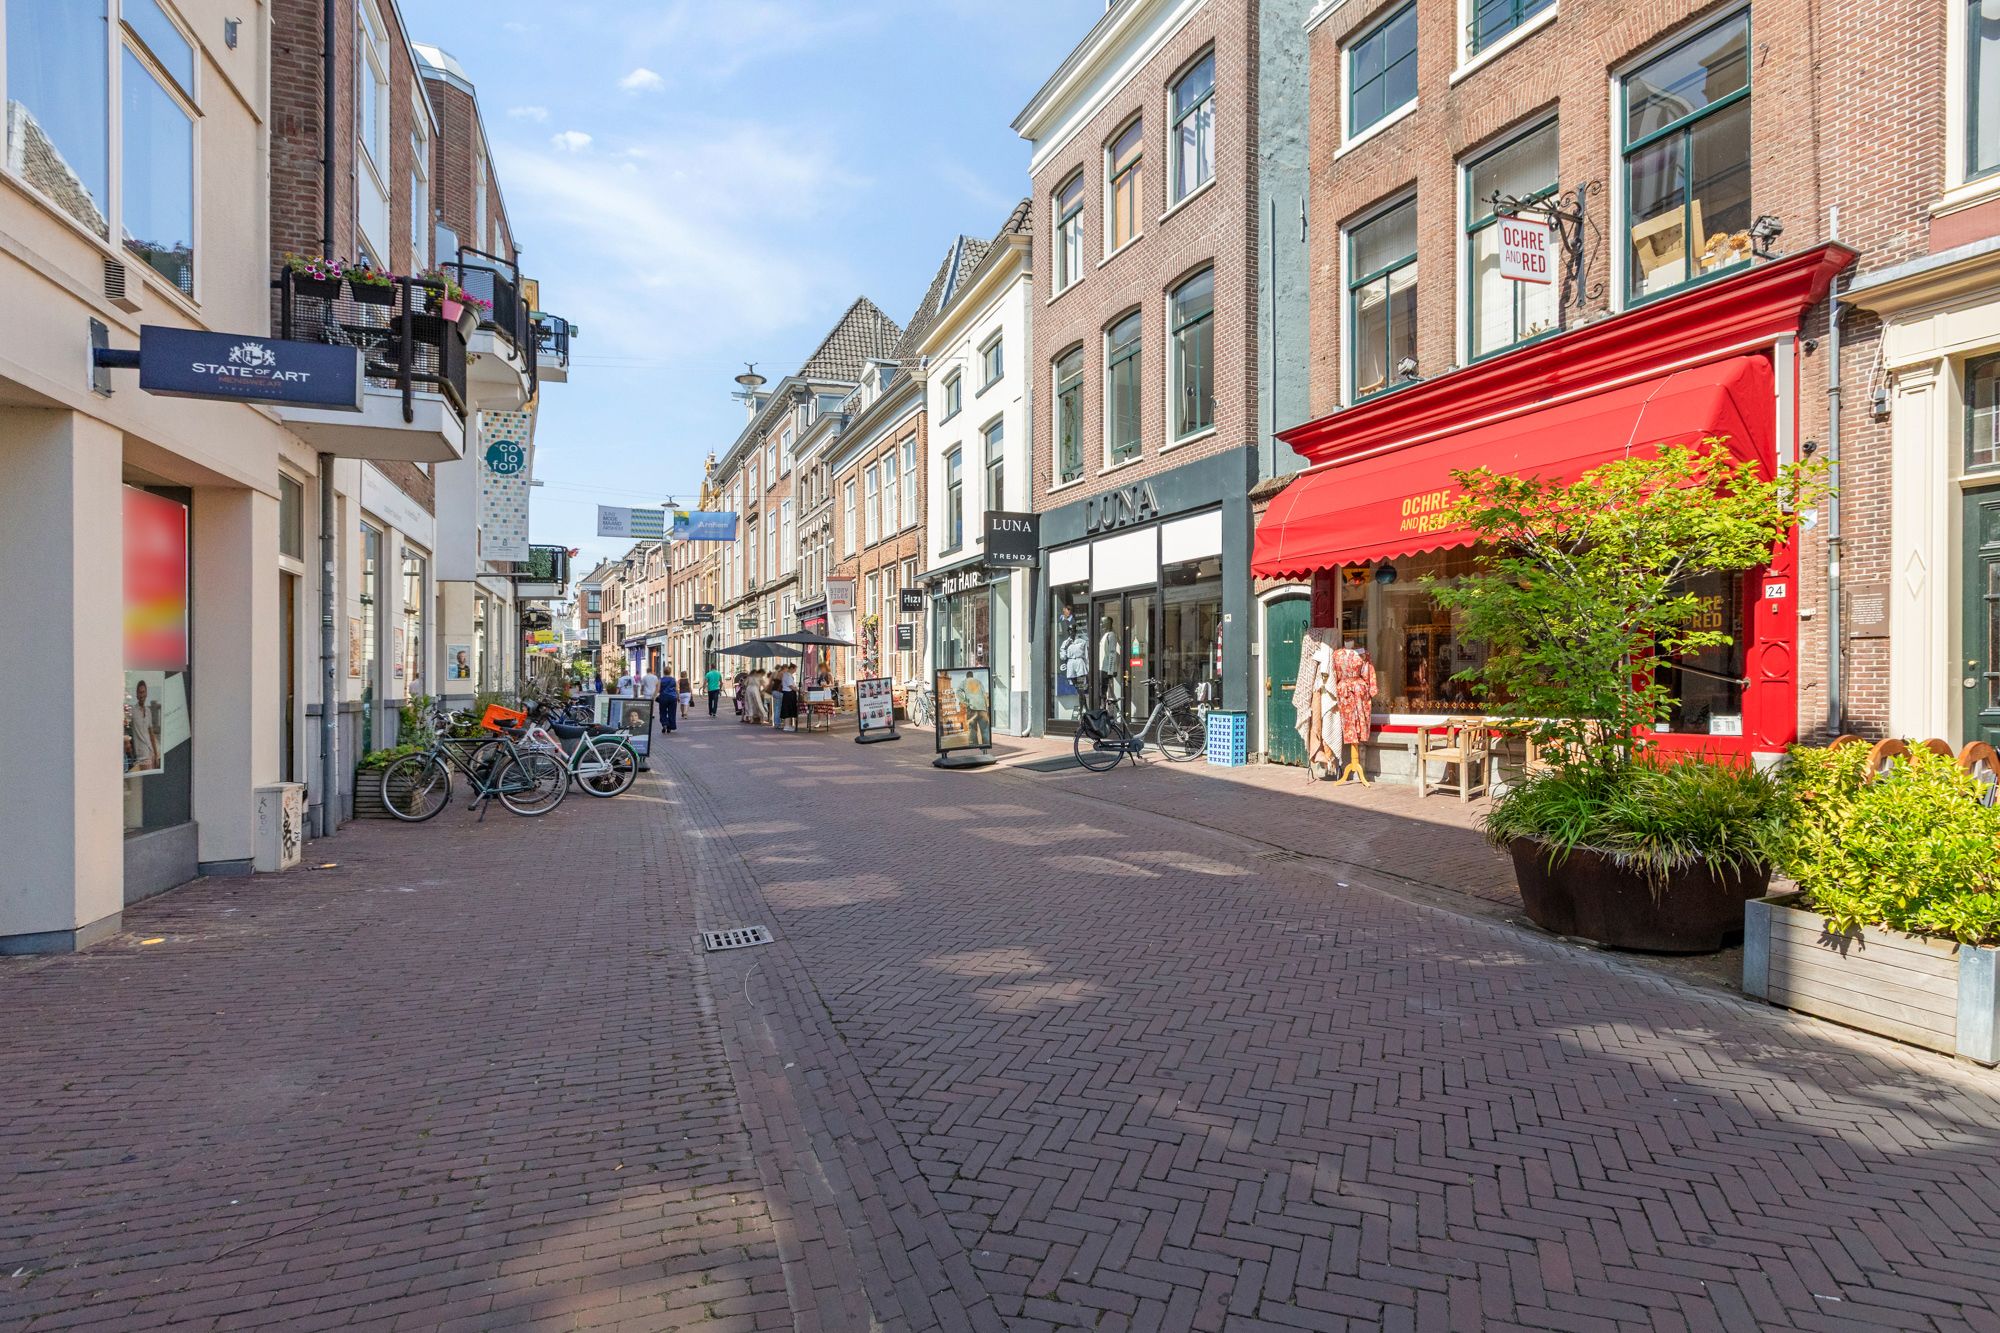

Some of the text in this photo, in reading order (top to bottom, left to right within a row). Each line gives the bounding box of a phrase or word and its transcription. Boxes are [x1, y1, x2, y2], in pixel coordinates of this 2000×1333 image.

[1503, 226, 1545, 251] OCHRE
[1505, 249, 1546, 273] AND RED
[191, 362, 311, 383] STATE OF ART
[492, 460, 518, 471] fon
[1086, 481, 1159, 534] LUNA
[1401, 489, 1451, 517] OCHRE
[992, 518, 1032, 533] LUNA
[1399, 517, 1419, 532] AND
[992, 552, 1033, 561] TRENDZ
[942, 570, 978, 595] HIZI HAIR
[903, 594, 921, 603] HIZI
[1767, 585, 1784, 598] 24
[1692, 612, 1723, 629] RED
